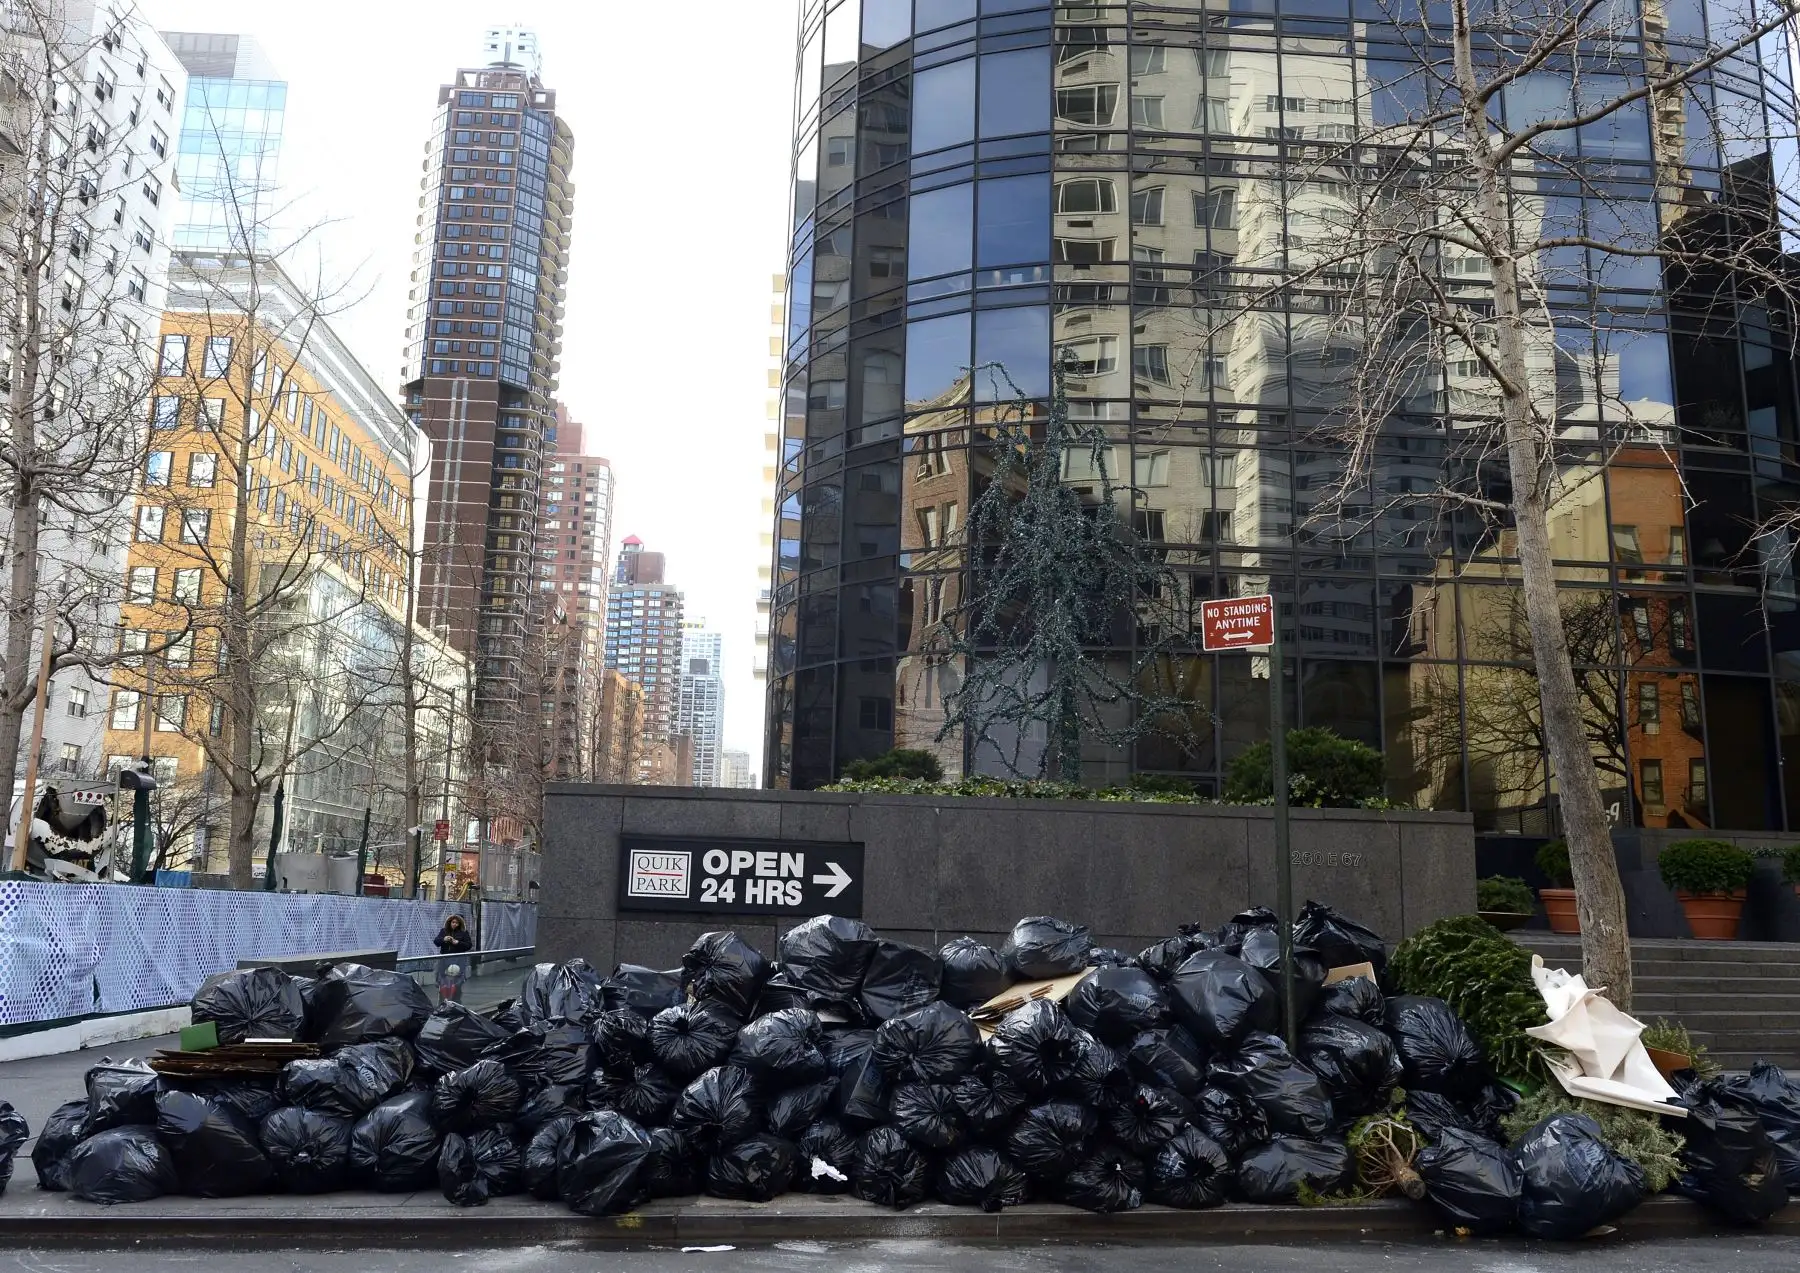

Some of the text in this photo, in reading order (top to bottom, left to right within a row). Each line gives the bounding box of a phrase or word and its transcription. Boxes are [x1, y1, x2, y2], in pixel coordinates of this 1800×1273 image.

[1207, 603, 1267, 618] NO STANDING
[1215, 616, 1261, 630] ANYTIME
[637, 855, 683, 871] QUIK
[702, 849, 805, 878] OPEN
[1327, 852, 1338, 866] E
[1341, 852, 1362, 867] 67
[636, 877, 683, 892] PARK
[700, 878, 803, 906] 24 HRS
